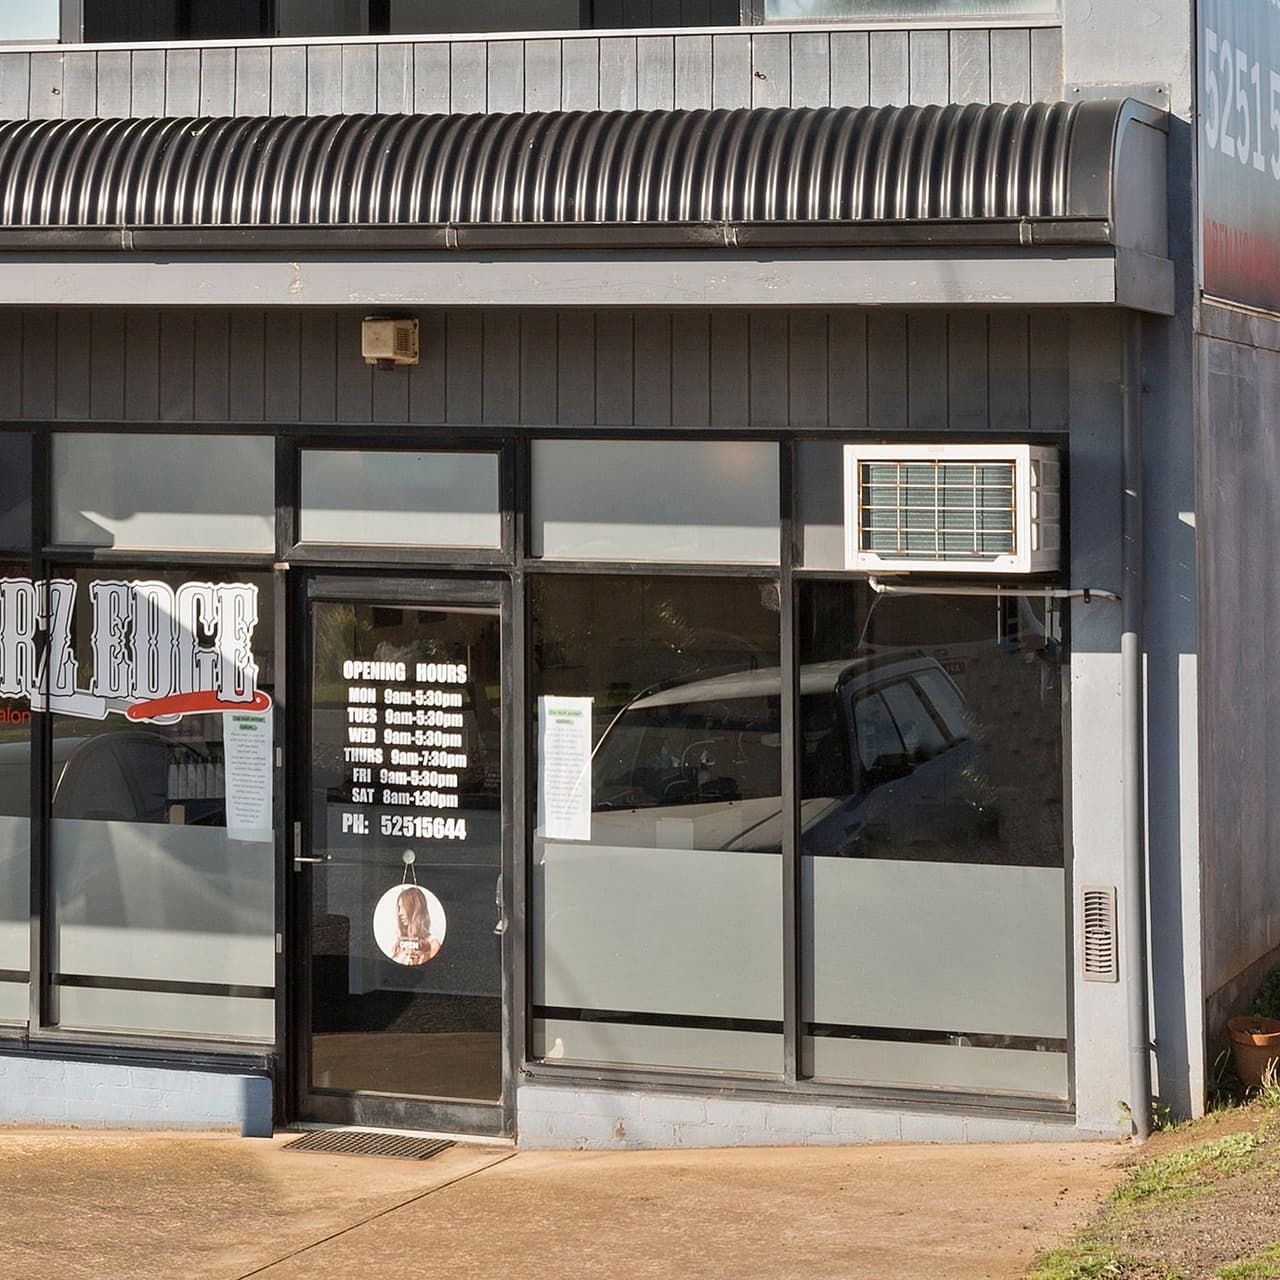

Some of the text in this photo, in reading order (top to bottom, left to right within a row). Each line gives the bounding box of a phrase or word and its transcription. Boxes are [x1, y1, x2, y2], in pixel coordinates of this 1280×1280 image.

[1204, 27, 1266, 172] 5251
[90, 580, 259, 702] EDGE
[343, 660, 468, 684] OPENING HOURS
[348, 687, 463, 707] MON 9am-5:30pm
[347, 707, 464, 728] TUES 9am-5:30pm
[348, 727, 463, 748] WED 9am-5:30pm
[344, 747, 468, 768] THURS 9am-7:30pm
[353, 768, 459, 788] FRI 9am-5:30pm
[352, 788, 459, 809] SAT 8am-1:30pm
[342, 813, 467, 840] PH: 52515644
